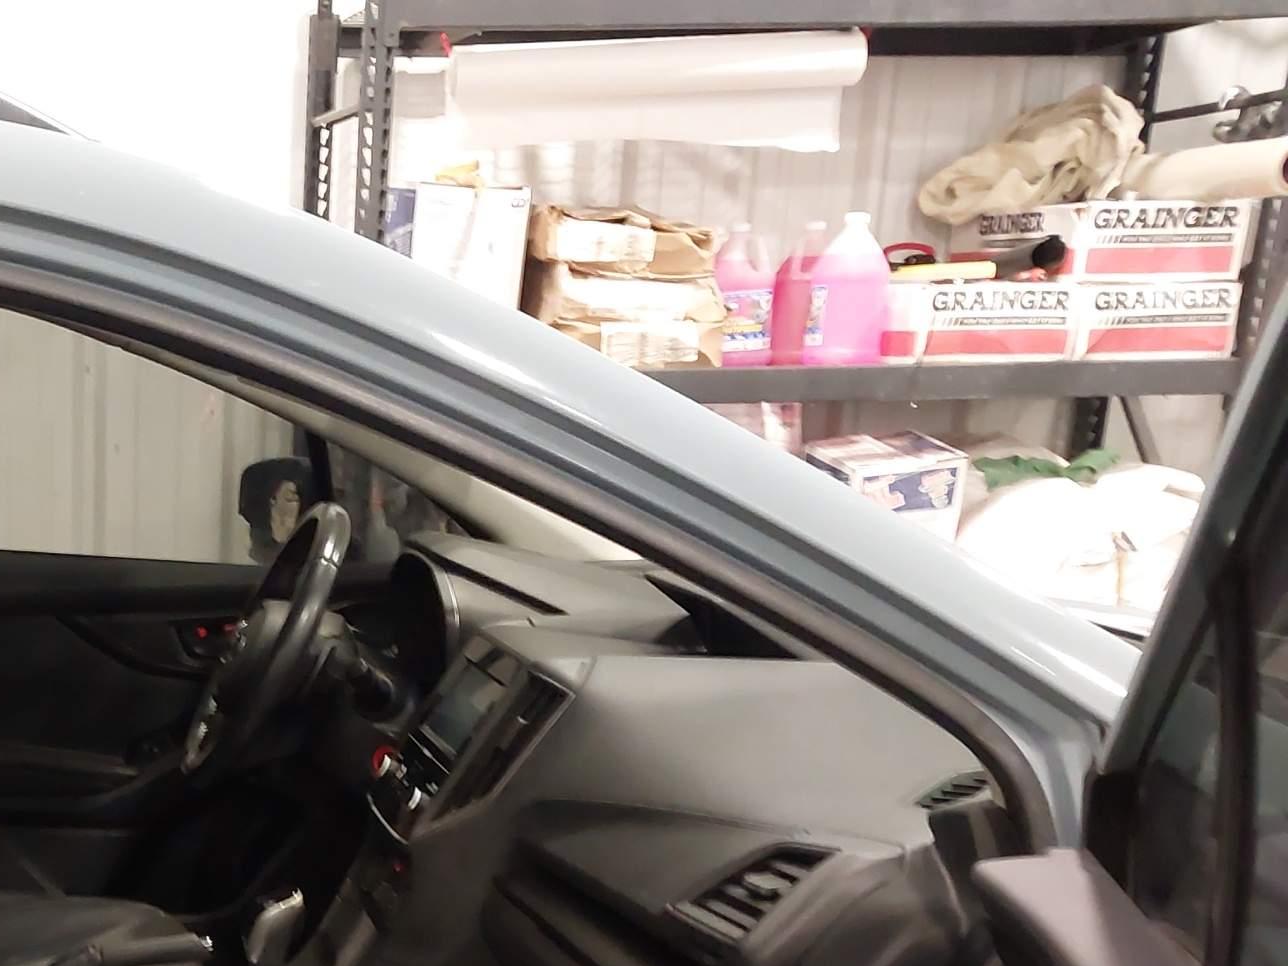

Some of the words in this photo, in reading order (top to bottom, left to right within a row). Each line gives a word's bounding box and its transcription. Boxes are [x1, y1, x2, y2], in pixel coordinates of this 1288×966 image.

[978, 211, 1045, 236] GRAINGER
[1093, 205, 1240, 229] GRAINGER
[932, 289, 1070, 312] GRAINGER
[1094, 287, 1233, 311] GRAINGER
